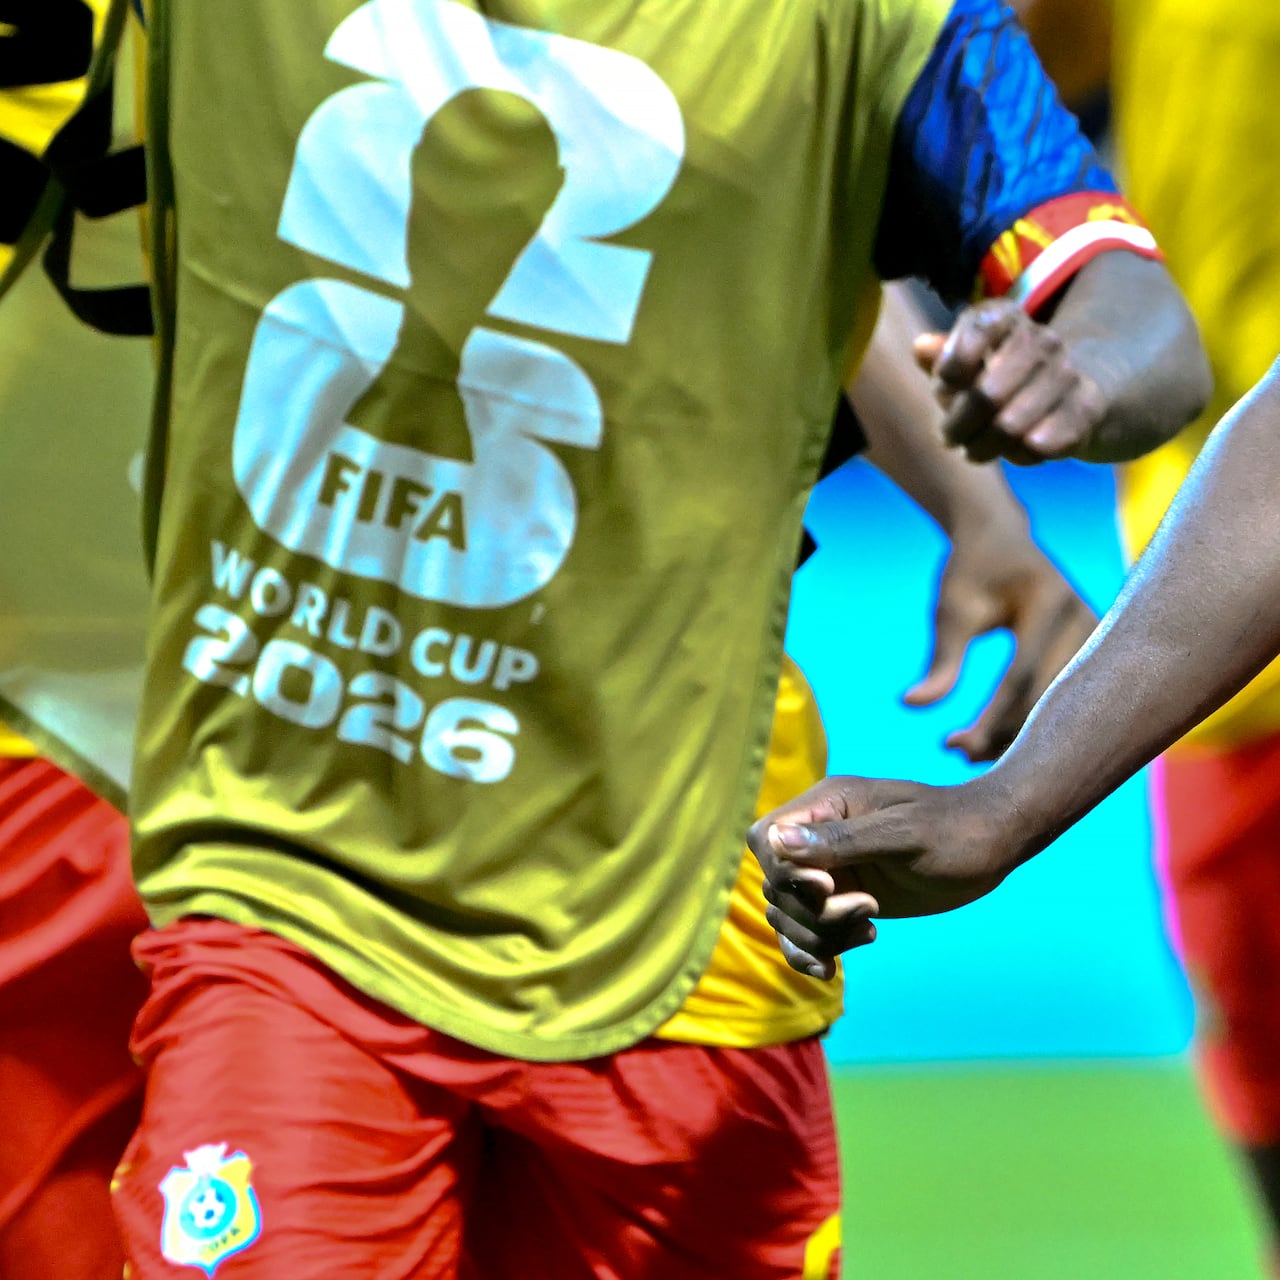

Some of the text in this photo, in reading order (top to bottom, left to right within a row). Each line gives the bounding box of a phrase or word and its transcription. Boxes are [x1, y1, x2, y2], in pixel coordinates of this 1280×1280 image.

[317, 452, 468, 553] FIFA
[210, 538, 539, 691] WORLD CUP
[182, 603, 520, 784] 2026
